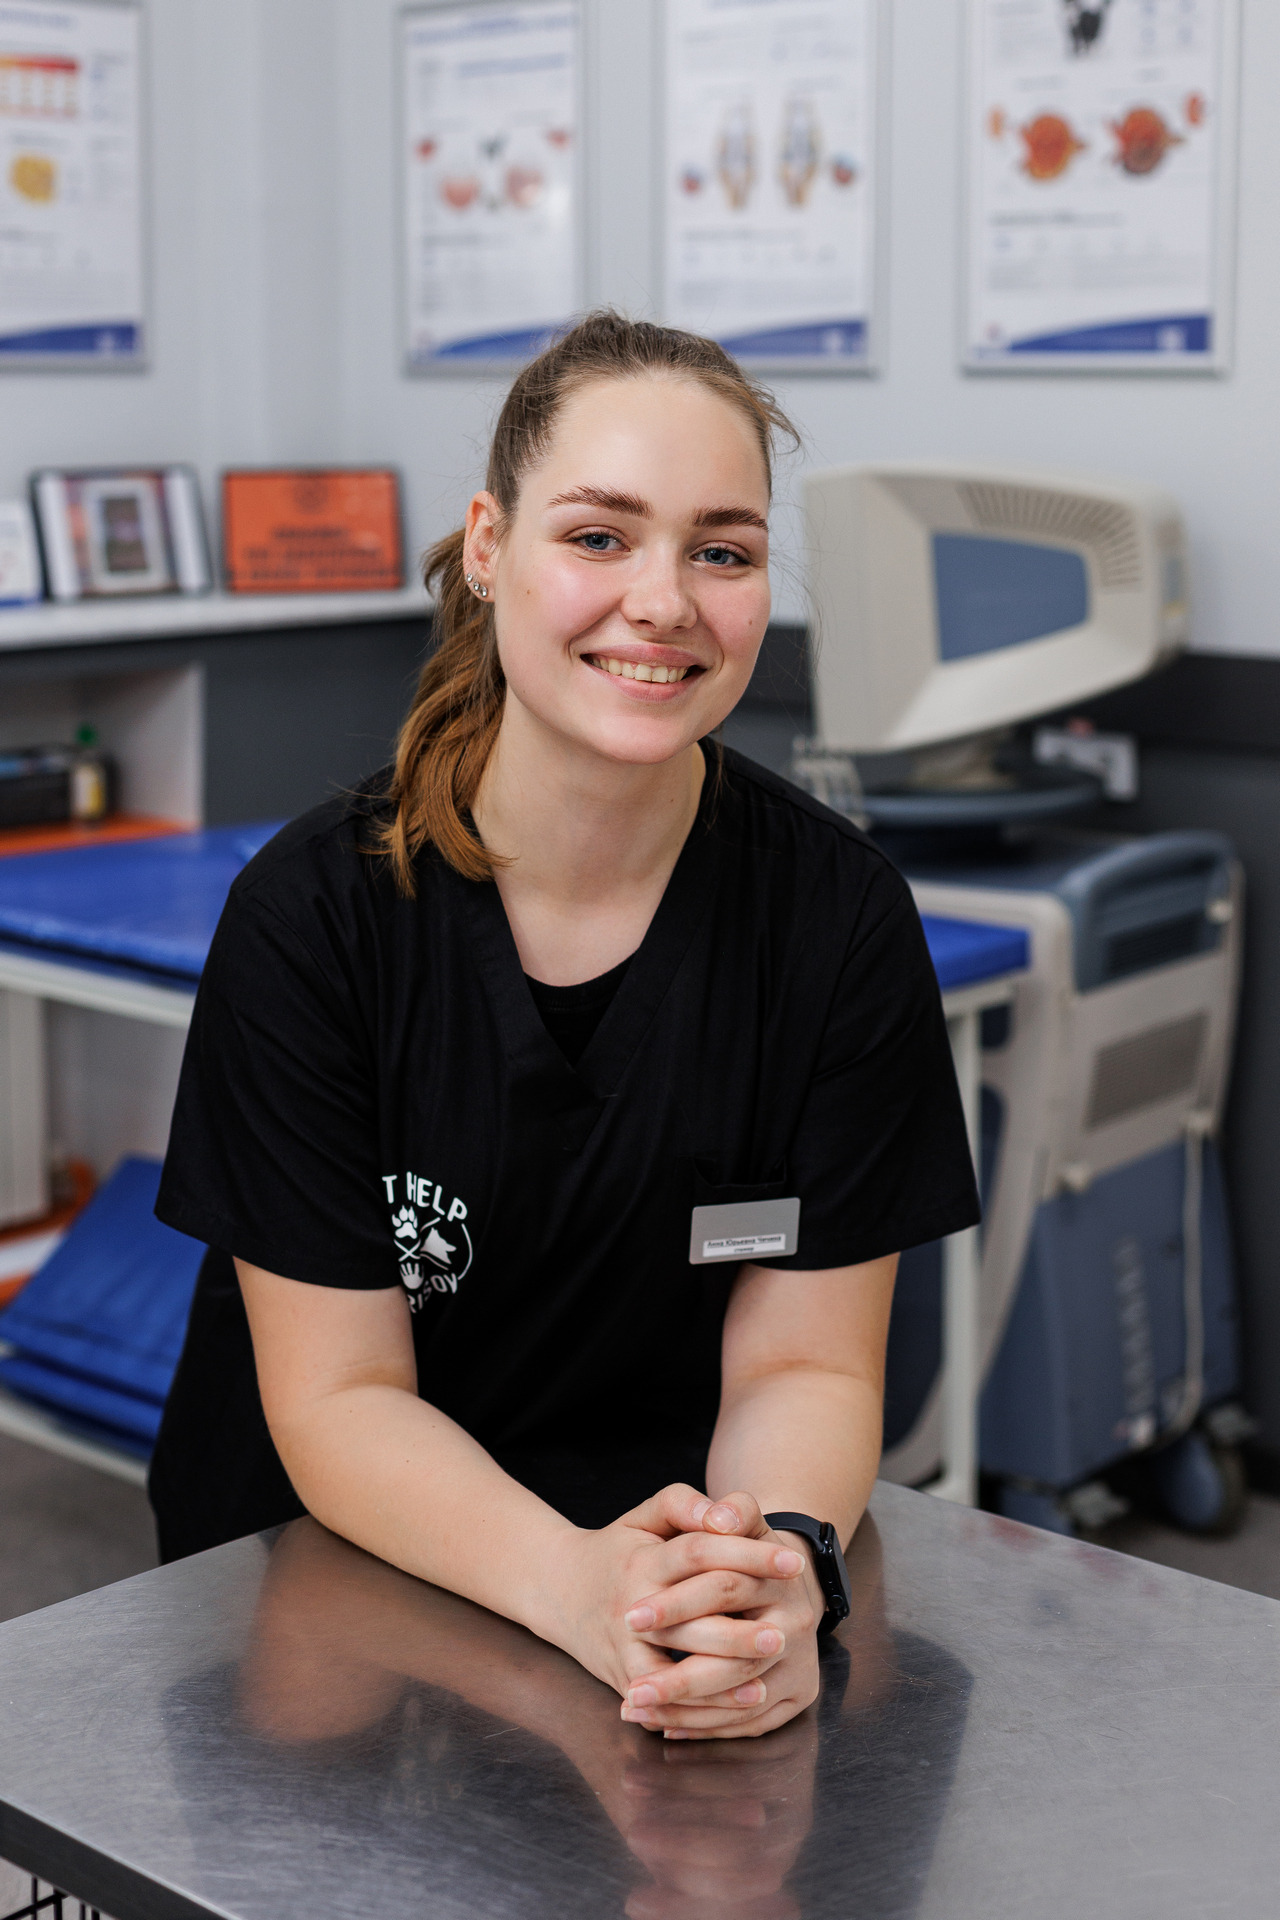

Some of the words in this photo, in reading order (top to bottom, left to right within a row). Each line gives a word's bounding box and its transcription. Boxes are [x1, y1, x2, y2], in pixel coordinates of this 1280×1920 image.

[381, 1174, 398, 1204] T
[406, 1171, 468, 1222] HELP
[407, 1272, 458, 1314] RISOV
